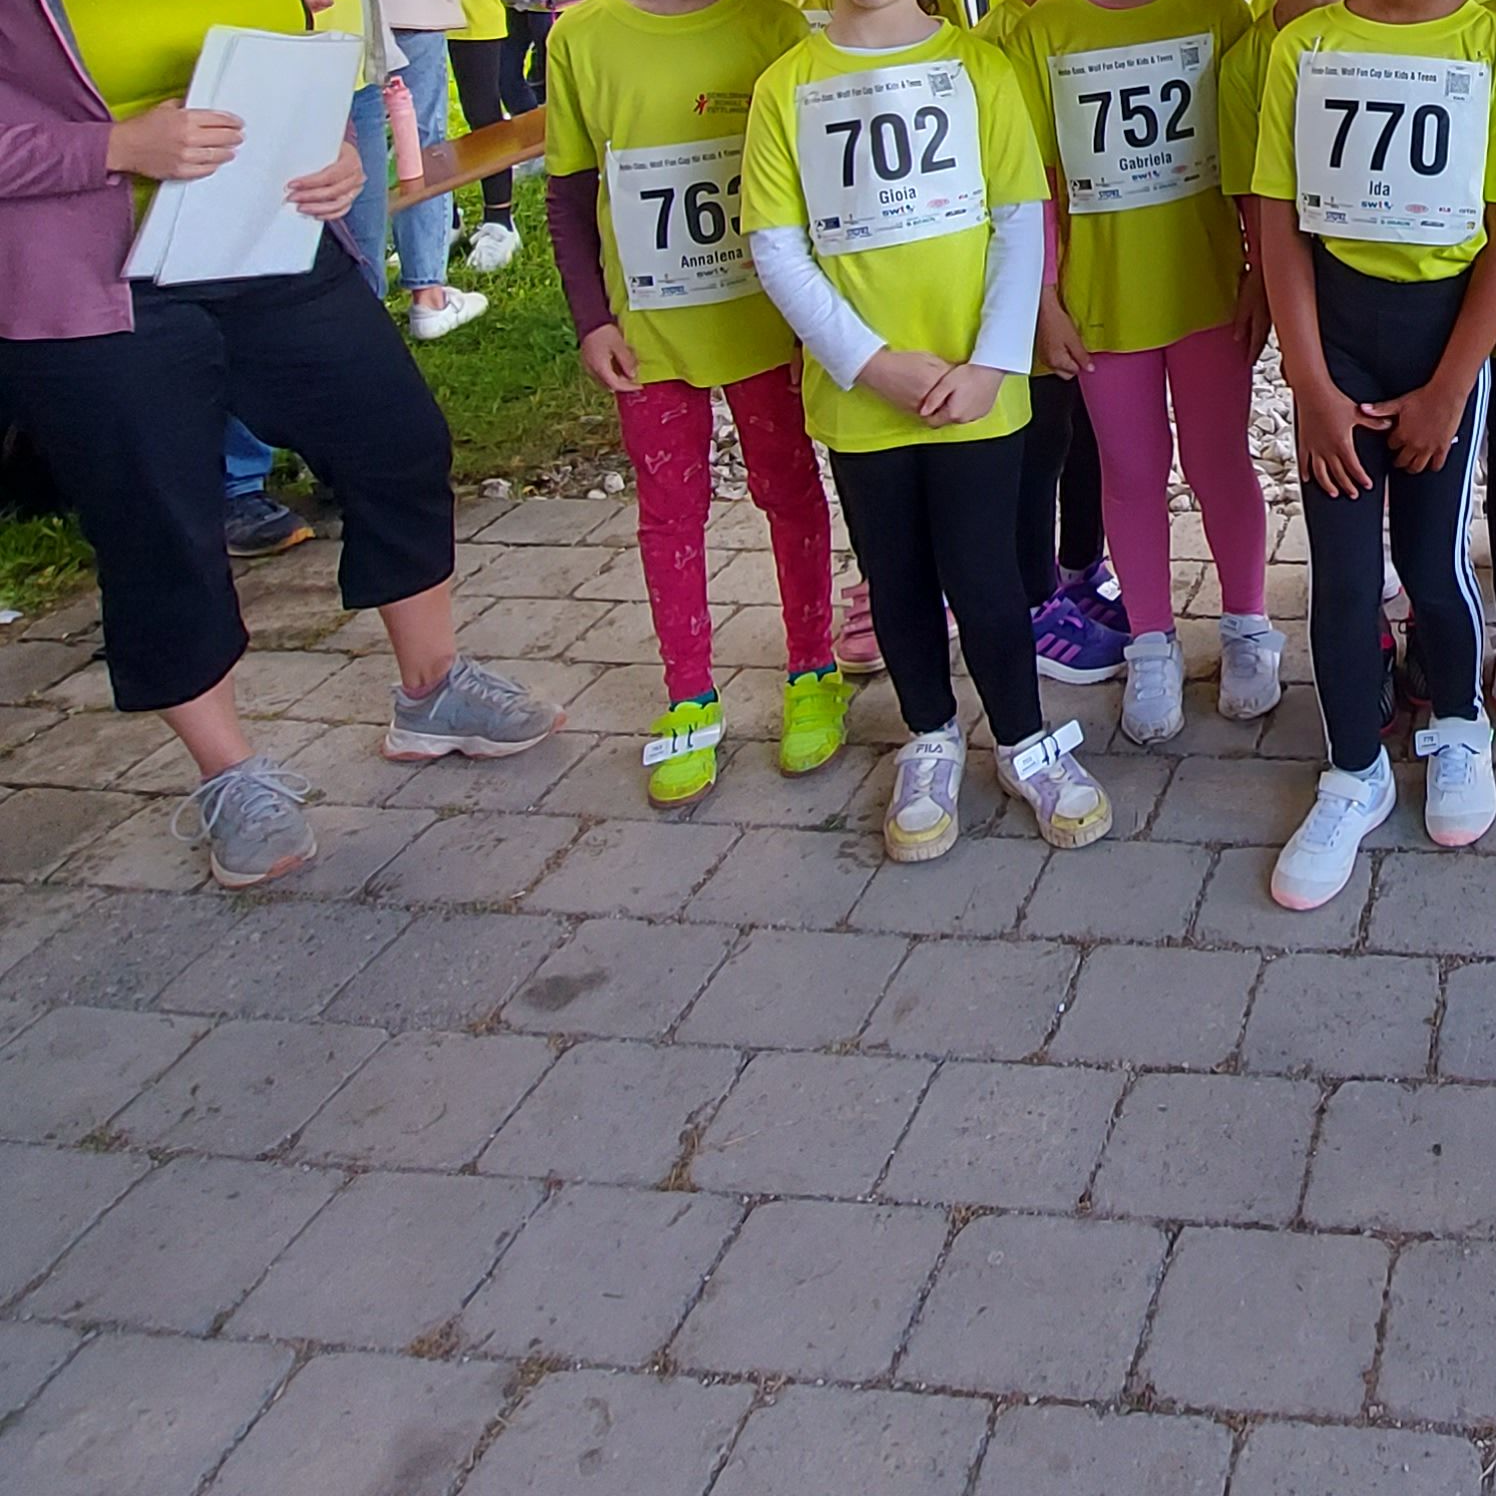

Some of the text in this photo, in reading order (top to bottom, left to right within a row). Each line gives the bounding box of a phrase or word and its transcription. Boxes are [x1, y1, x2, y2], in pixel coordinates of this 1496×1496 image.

[1078, 79, 1194, 153] 752
[825, 106, 956, 187] 702
[1325, 99, 1450, 176] 770
[1119, 152, 1172, 171] Gabriela
[879, 187, 917, 204] Gioia
[1369, 180, 1390, 196] Ida
[681, 248, 743, 269] Annalena
[916, 744, 943, 753] FILA
